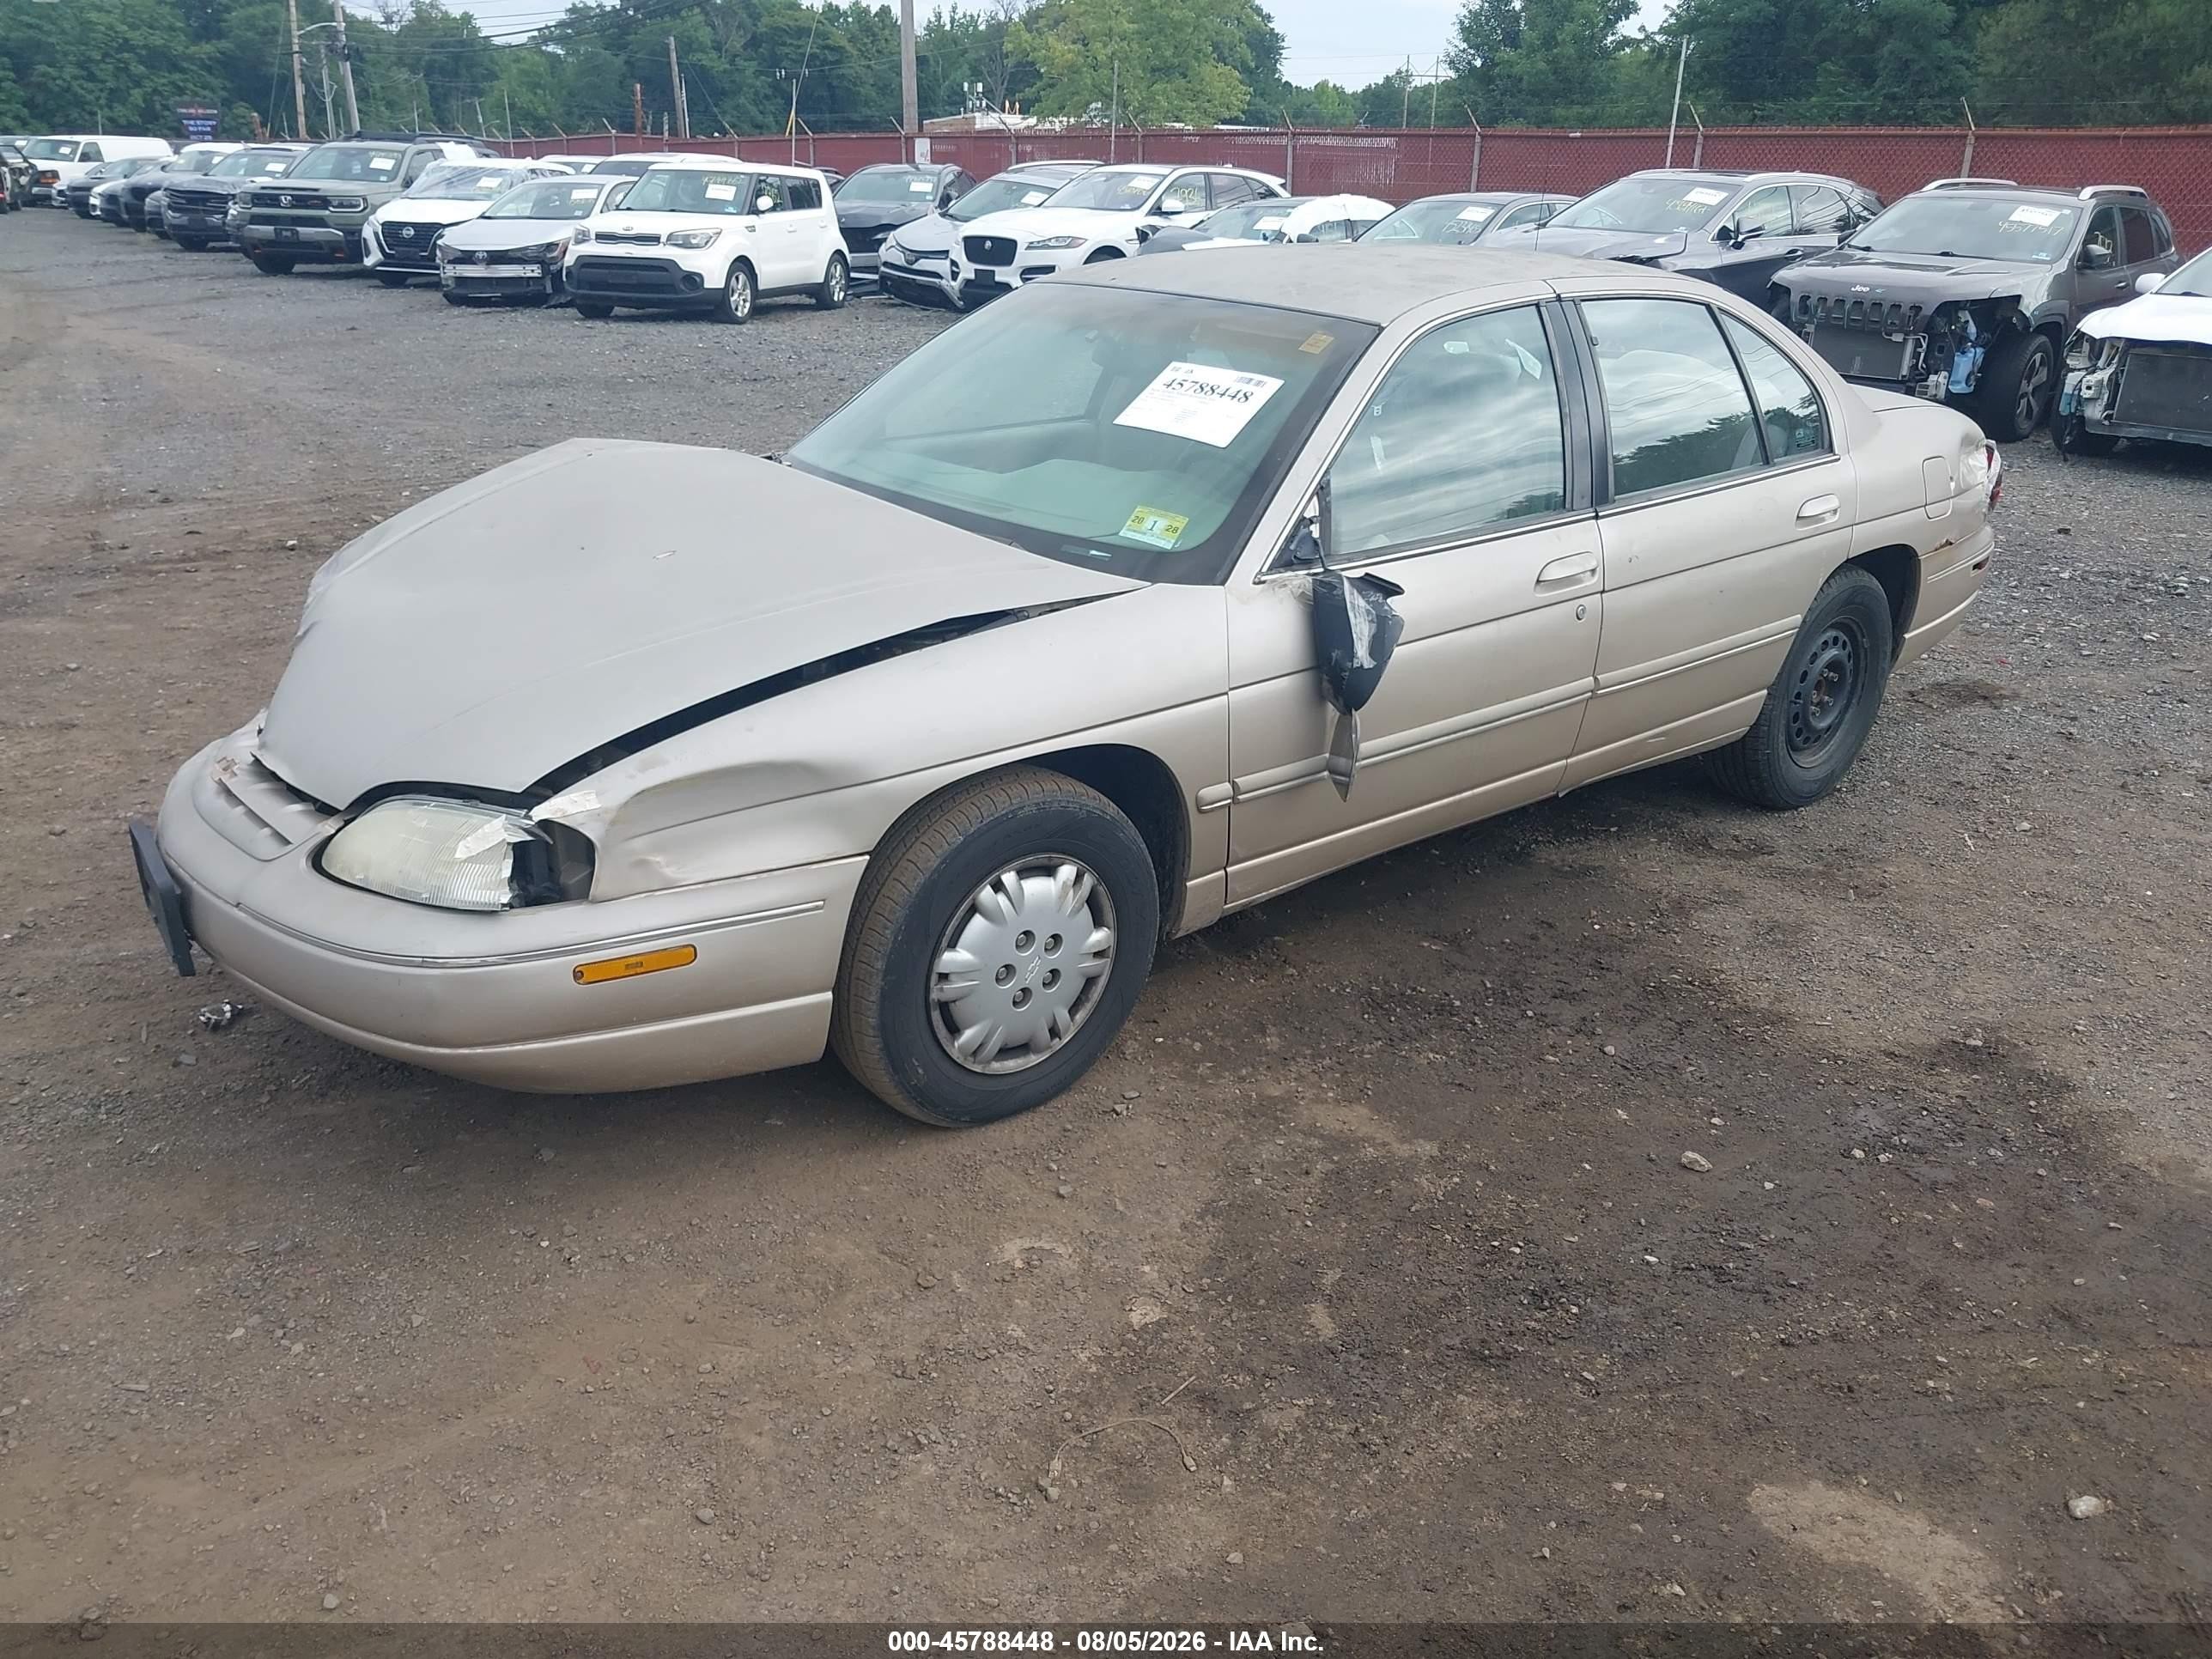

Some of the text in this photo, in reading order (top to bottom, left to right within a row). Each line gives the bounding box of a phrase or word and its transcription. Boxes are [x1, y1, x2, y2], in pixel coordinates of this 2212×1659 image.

[1163, 378, 1254, 404] 45788448
[1132, 515, 1146, 525] 20
[1165, 525, 1180, 534] 28
